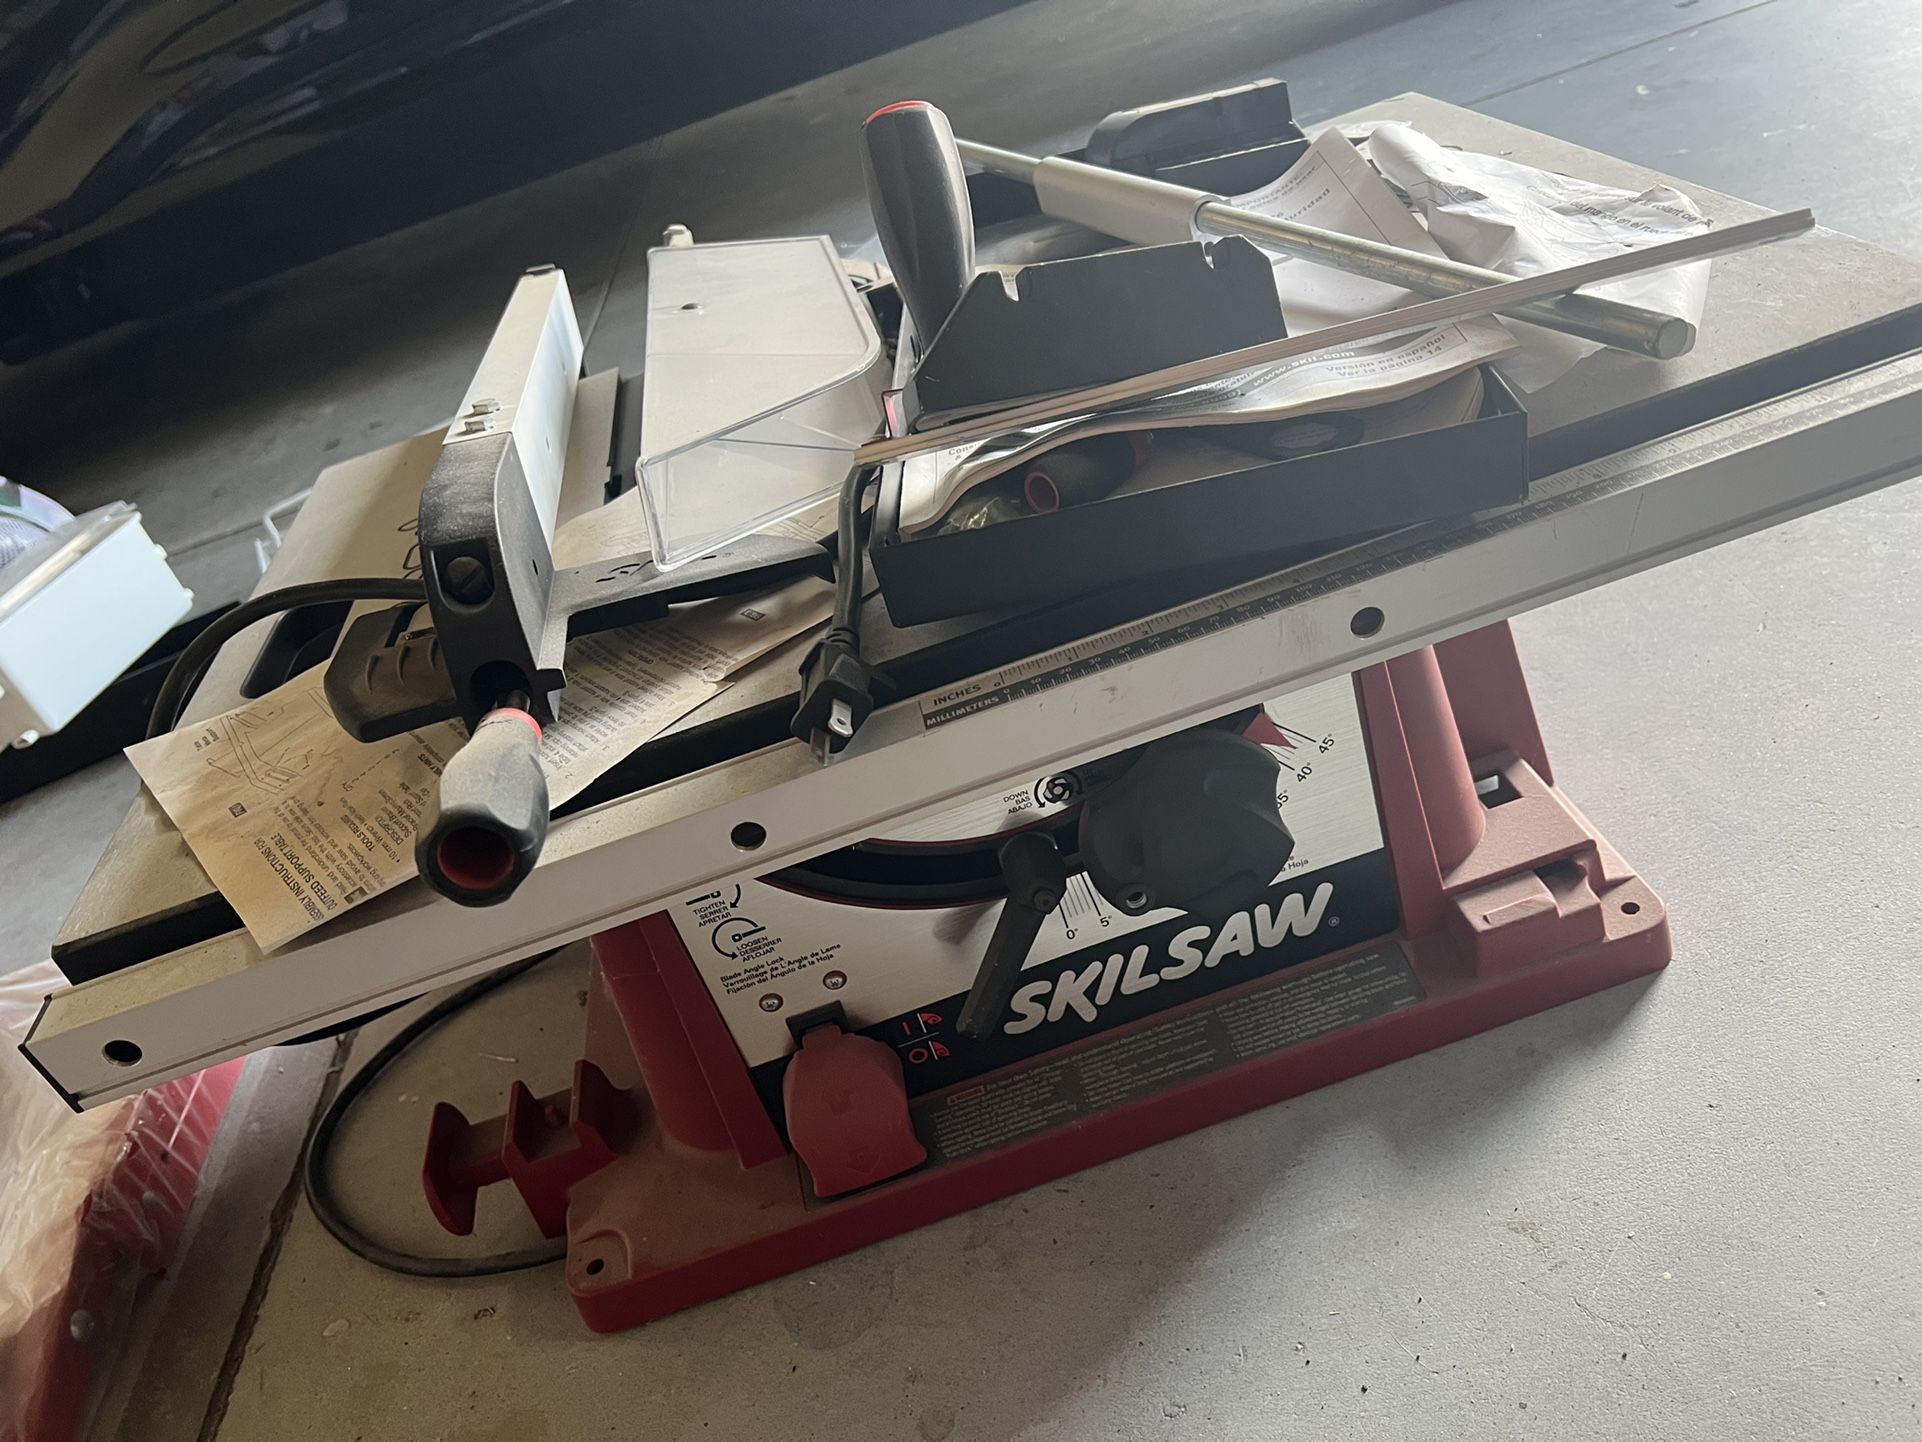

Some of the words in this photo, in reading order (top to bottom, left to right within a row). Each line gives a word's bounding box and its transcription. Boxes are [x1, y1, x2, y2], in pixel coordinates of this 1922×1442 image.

[1285, 187, 1330, 221] uridad
[1378, 357, 1394, 365] en
[1396, 334, 1446, 362] español
[1427, 345, 1442, 356] 14
[1253, 349, 1356, 387] www.skil.com
[924, 695, 1000, 725] MILLIMETERS
[1089, 656, 1101, 665] 30
[1118, 646, 1131, 654] 40
[1148, 636, 1160, 644] 50
[931, 683, 982, 705] INCHES
[1318, 733, 1334, 754] 45°
[1296, 762, 1312, 783] 40°
[1002, 789, 1029, 803] DOWN
[1014, 795, 1031, 805] BAS
[1006, 801, 1033, 814] ABAJO
[272, 832, 290, 851] TABLE
[356, 830, 376, 852] TOOLS
[259, 845, 305, 898] INSTRUCTIONS
[282, 847, 315, 884] SUPPORT
[1289, 858, 1309, 870] Hoja
[308, 879, 337, 911] OUTFEED
[693, 900, 726, 915] TIGHTEN
[700, 907, 729, 920] SERRER
[698, 912, 732, 928] APRETAR
[736, 936, 768, 951] LOOSEN
[740, 938, 782, 957] DESSERRER
[742, 947, 775, 962] AFLOJAR
[1004, 882, 1335, 1036] SKILSAW
[721, 970, 742, 983] Blade
[744, 964, 765, 975] Angle
[766, 956, 785, 967] Lock
[723, 966, 768, 988] Verrouillage
[769, 962, 779, 970] de
[780, 955, 809, 970] L'Angle
[810, 951, 820, 959] de
[820, 944, 841, 954] Lame
[727, 981, 757, 995] Fijación
[758, 975, 770, 984] del
[816, 953, 834, 964] Hoja
